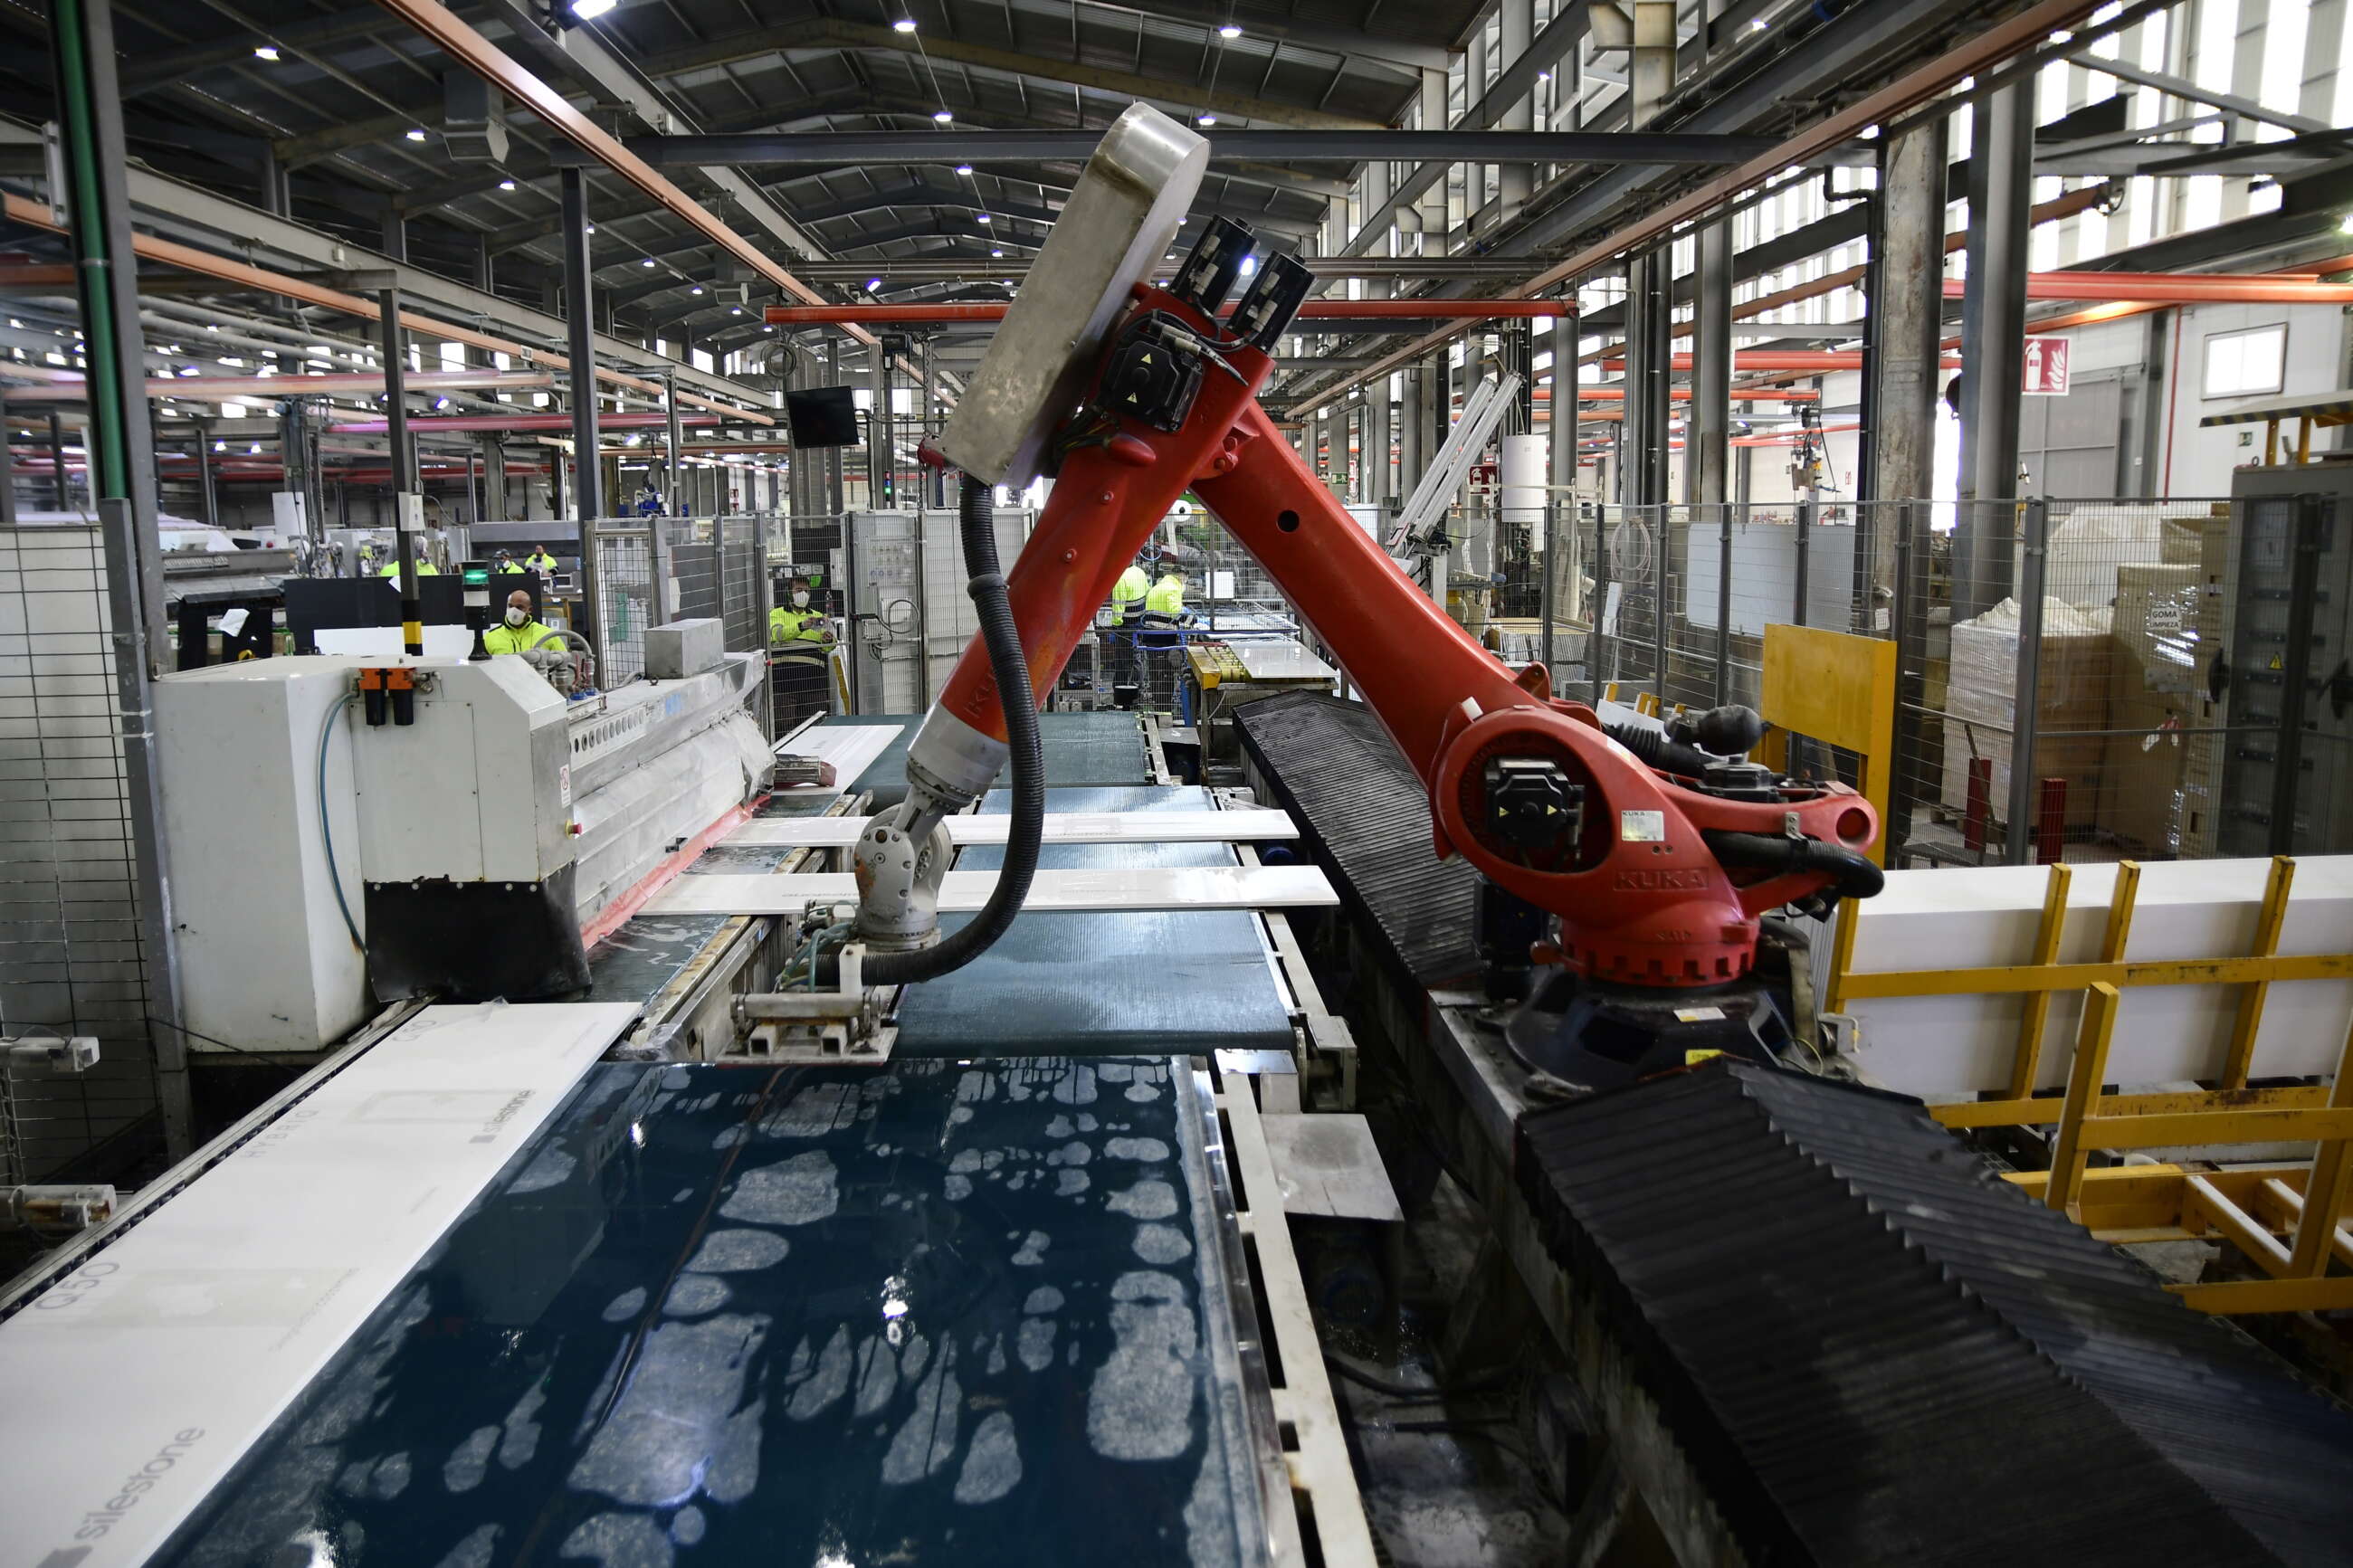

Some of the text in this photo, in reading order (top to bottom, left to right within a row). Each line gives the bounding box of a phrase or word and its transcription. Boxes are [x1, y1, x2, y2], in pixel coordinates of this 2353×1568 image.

[1616, 870, 1708, 889] KUKA
[480, 1088, 537, 1134] silestone
[73, 1426, 206, 1541] silestone
